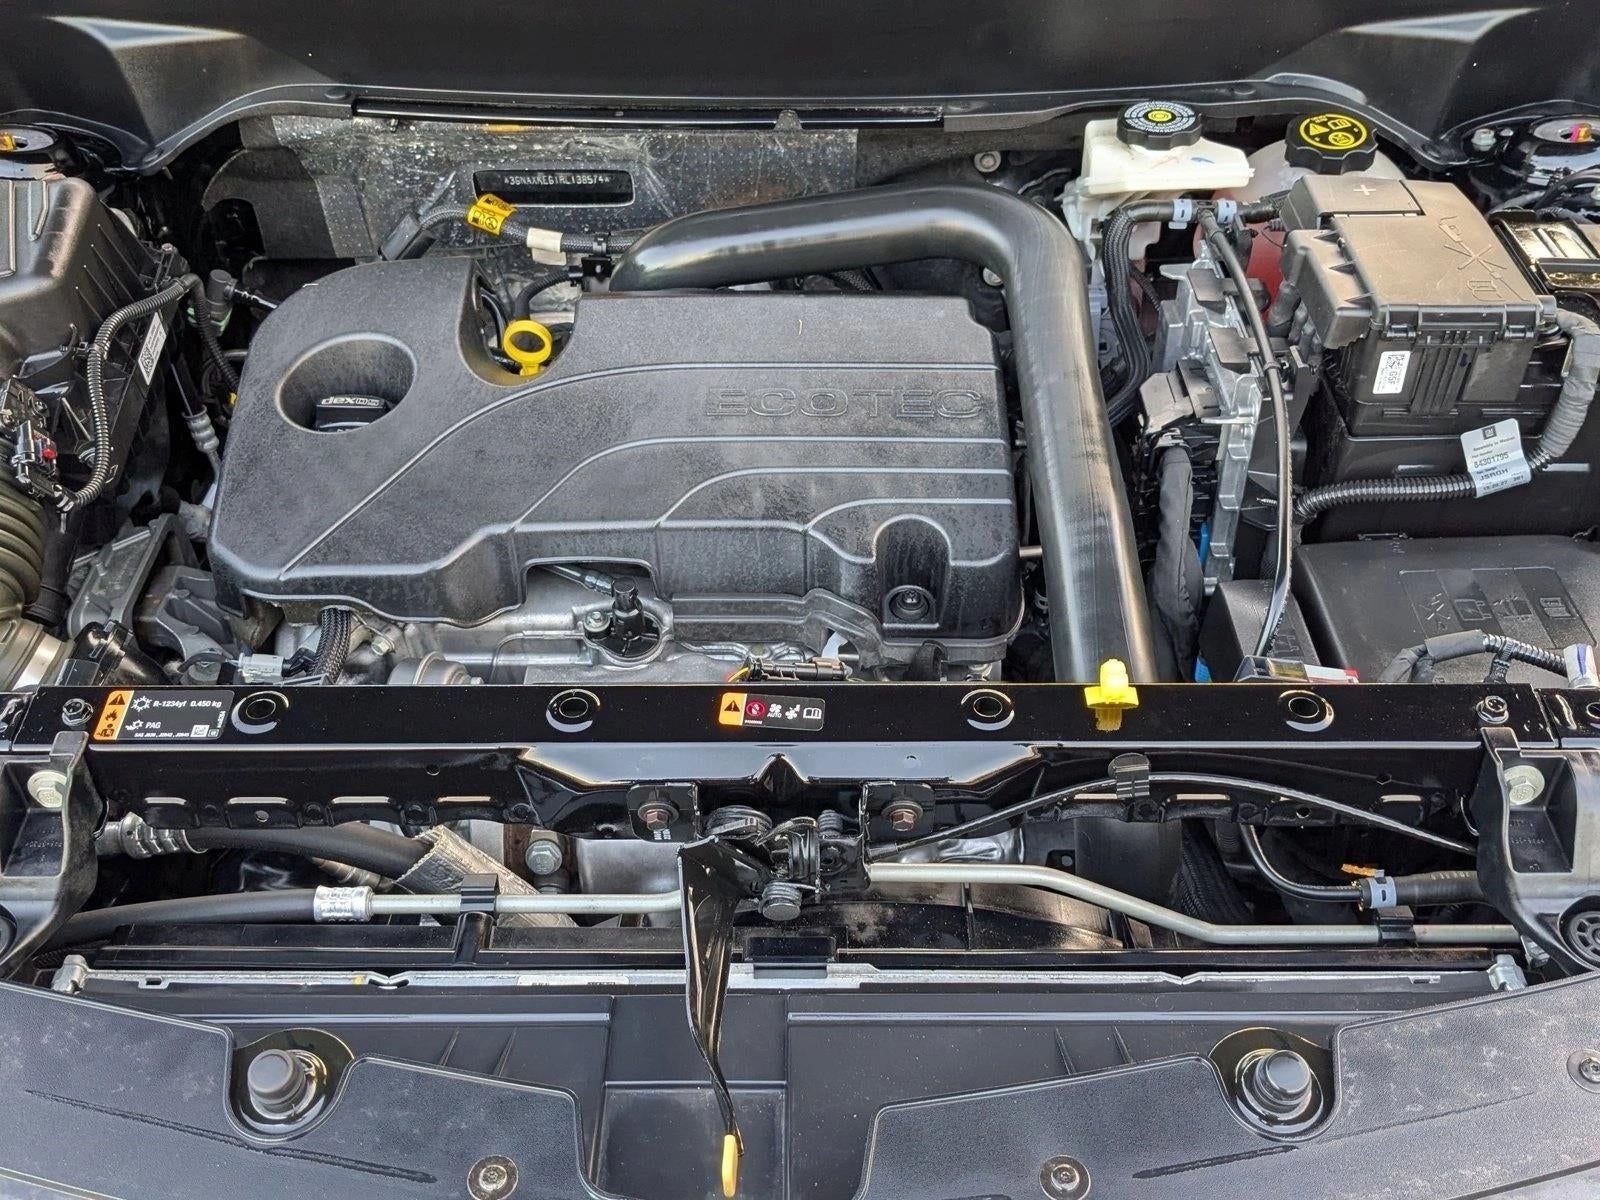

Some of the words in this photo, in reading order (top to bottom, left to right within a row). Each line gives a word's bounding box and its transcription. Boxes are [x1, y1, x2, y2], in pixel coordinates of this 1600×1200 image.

[706, 388, 982, 418] ECOTEC
[152, 700, 187, 709] R-1234yf
[190, 700, 211, 708] 0.450
[212, 701, 222, 709] kg
[145, 721, 162, 730] PAG
